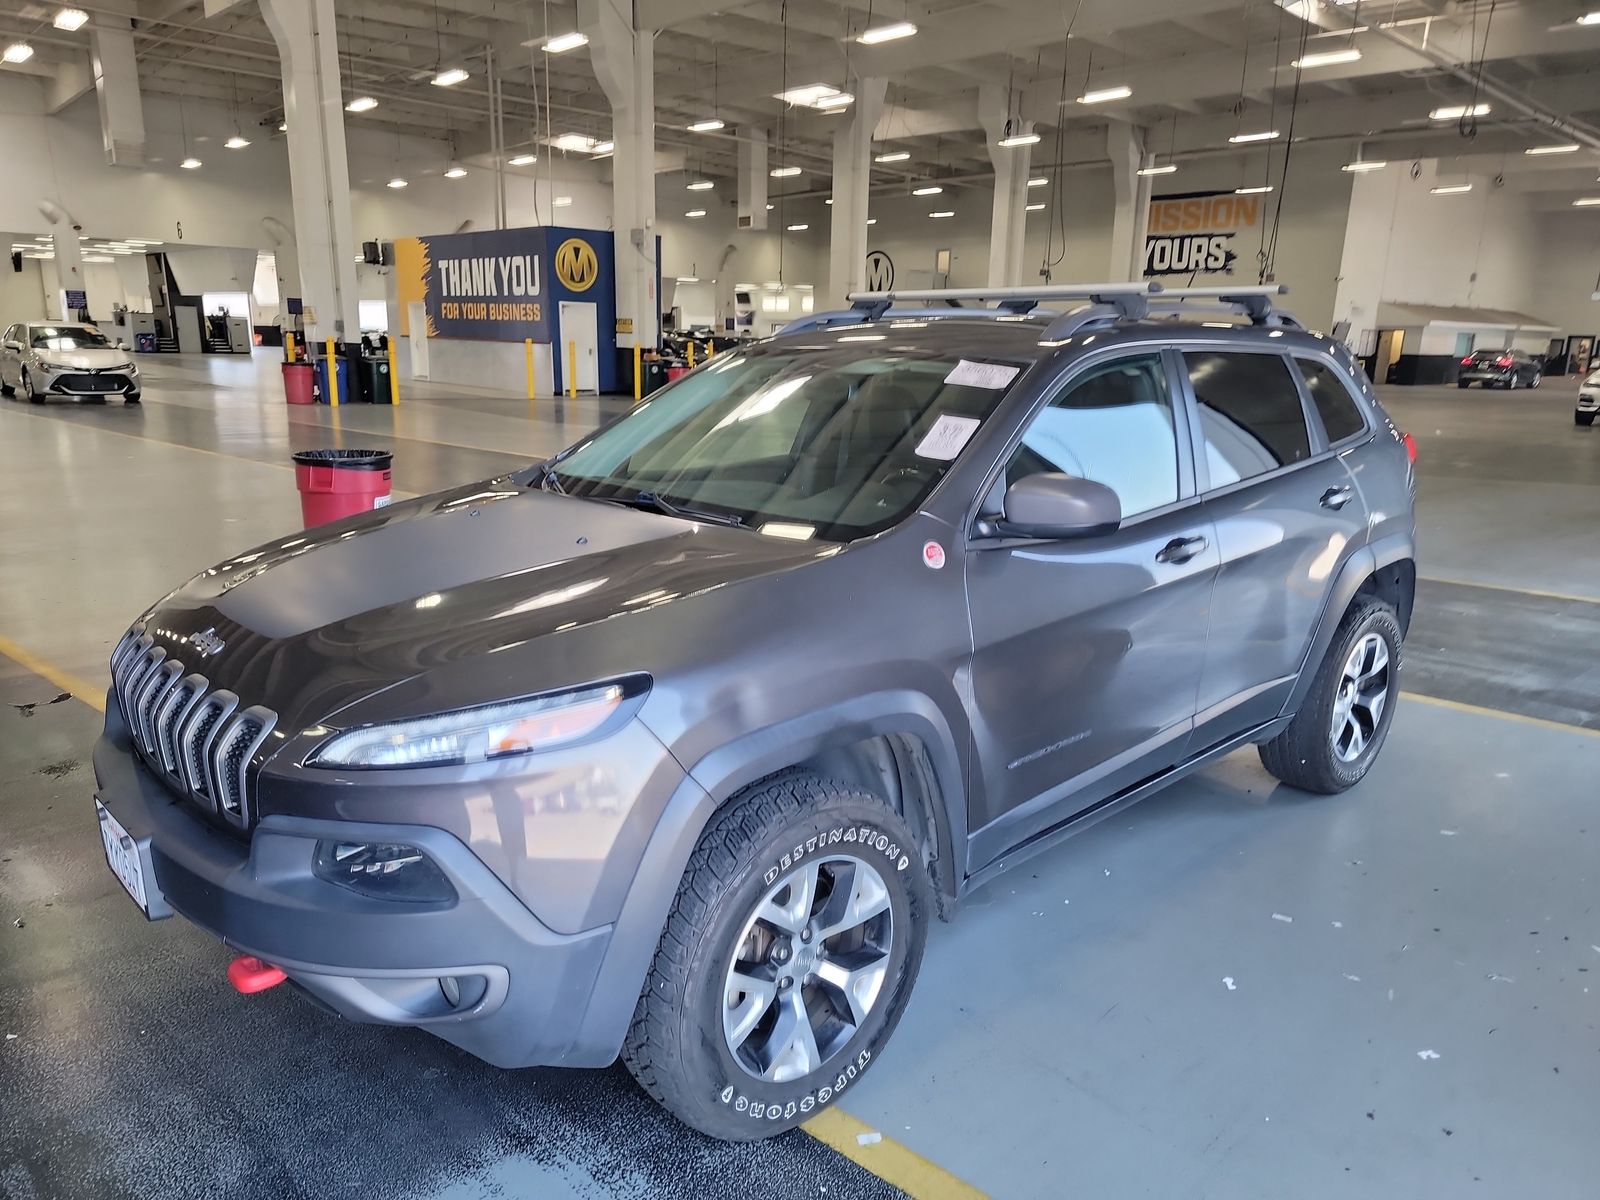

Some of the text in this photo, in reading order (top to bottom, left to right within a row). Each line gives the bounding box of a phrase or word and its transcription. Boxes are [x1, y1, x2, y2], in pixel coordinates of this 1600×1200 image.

[176, 221, 183, 240] 6
[438, 255, 541, 297] THANK YOU
[441, 302, 541, 322] FOR YOUR BUSINESS
[763, 827, 900, 886] DESTINATION
